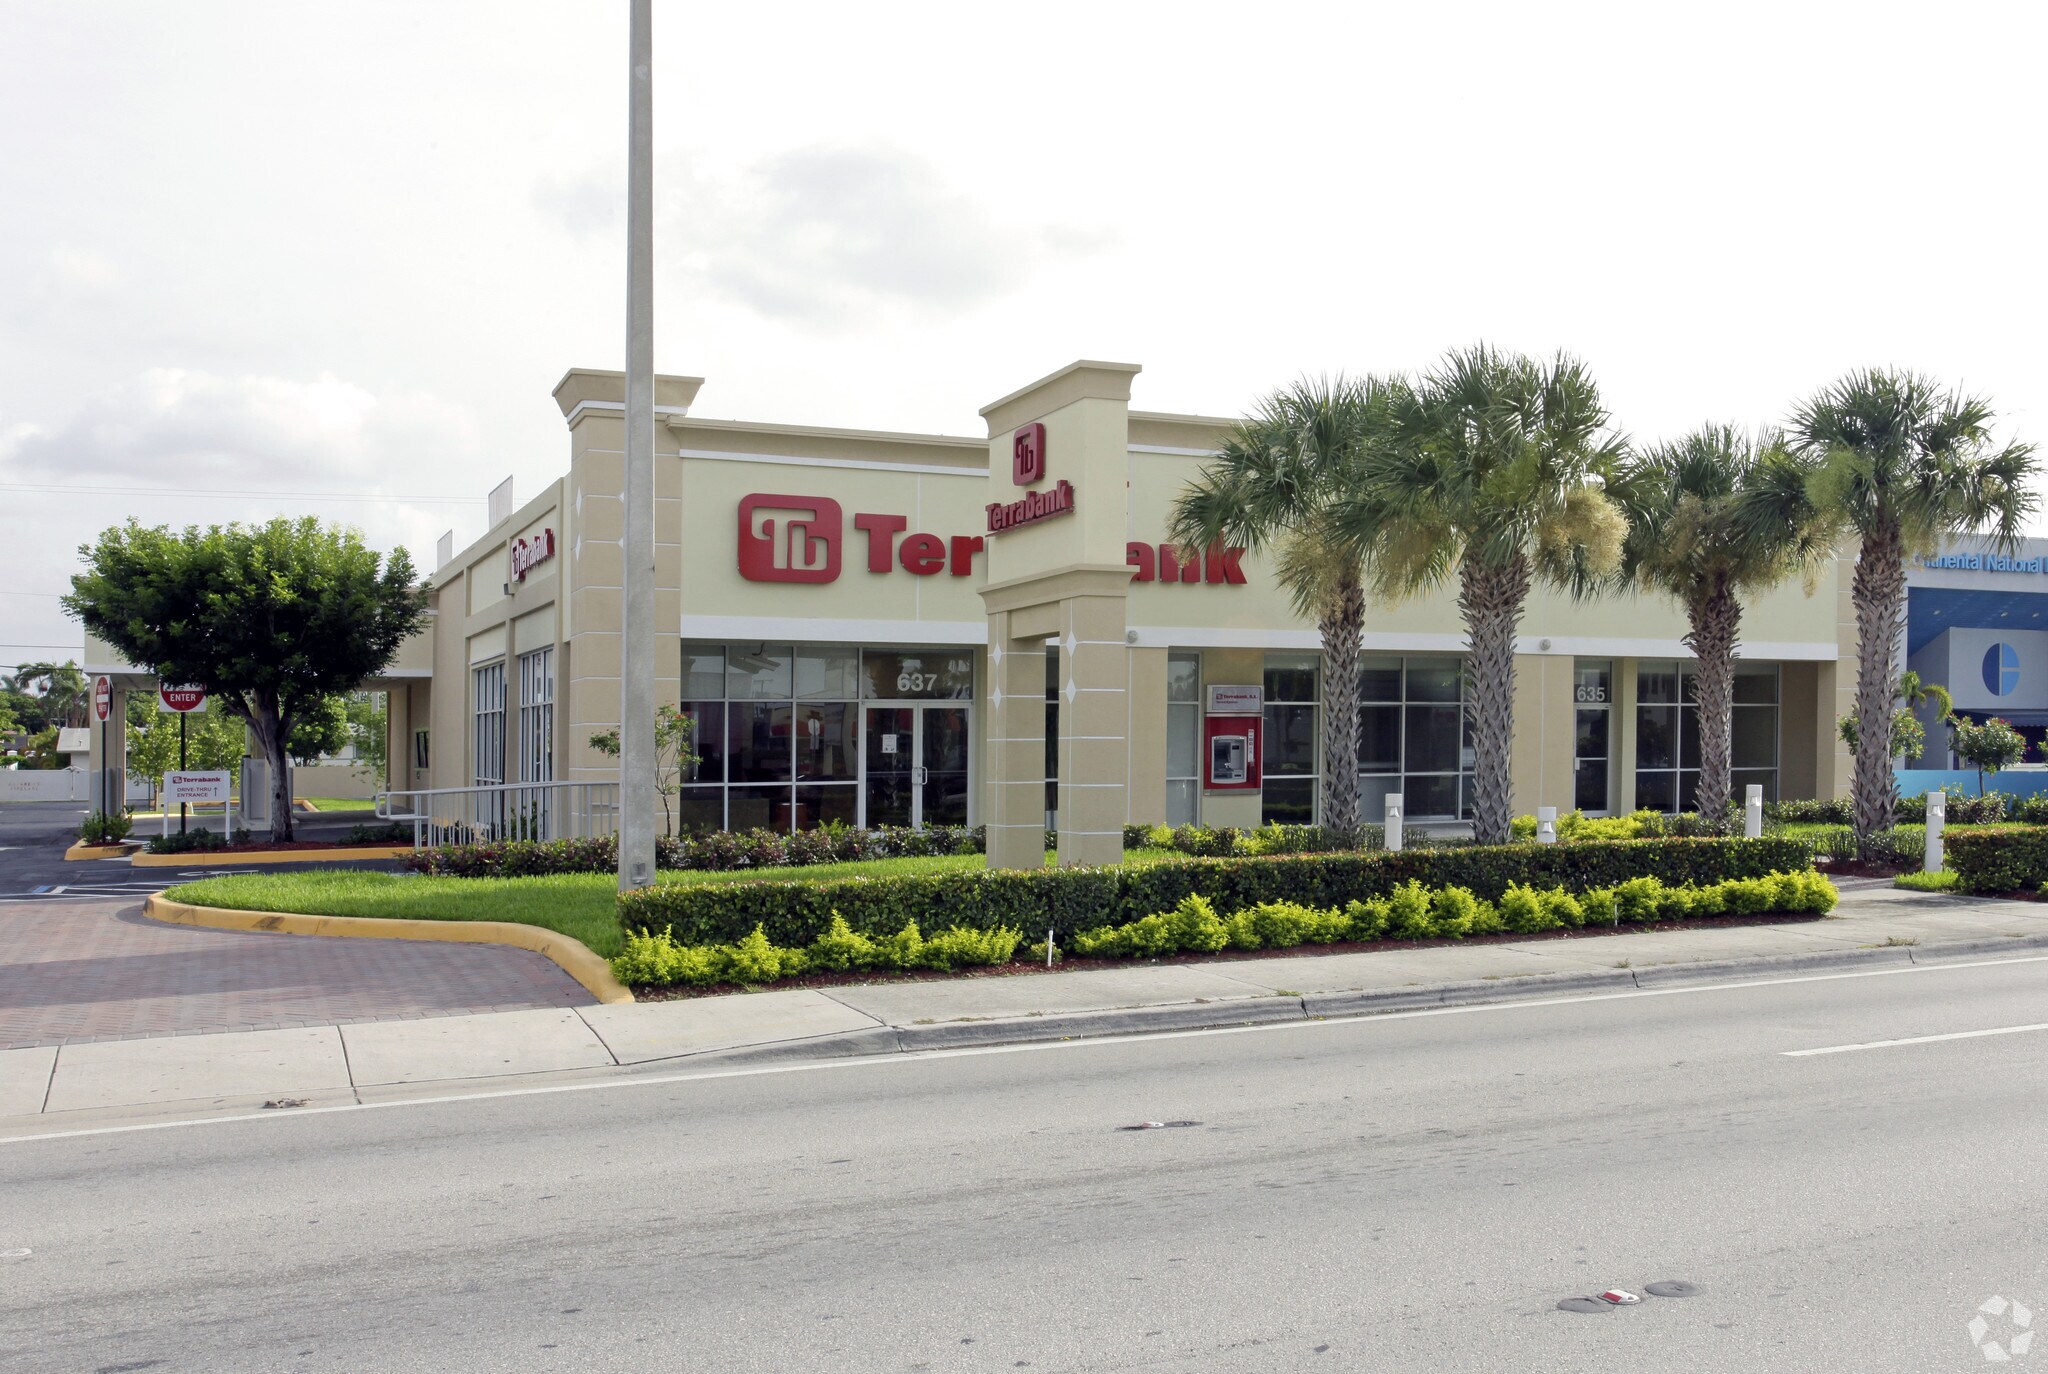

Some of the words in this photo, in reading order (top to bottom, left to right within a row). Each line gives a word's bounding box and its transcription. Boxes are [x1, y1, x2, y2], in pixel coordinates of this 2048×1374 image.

[985, 481, 1072, 532] Terrabank
[855, 513, 1247, 584] Terank
[1985, 553, 2042, 573] National
[897, 673, 938, 692] 637
[170, 694, 196, 702] ENTER
[1576, 686, 1606, 702] 635
